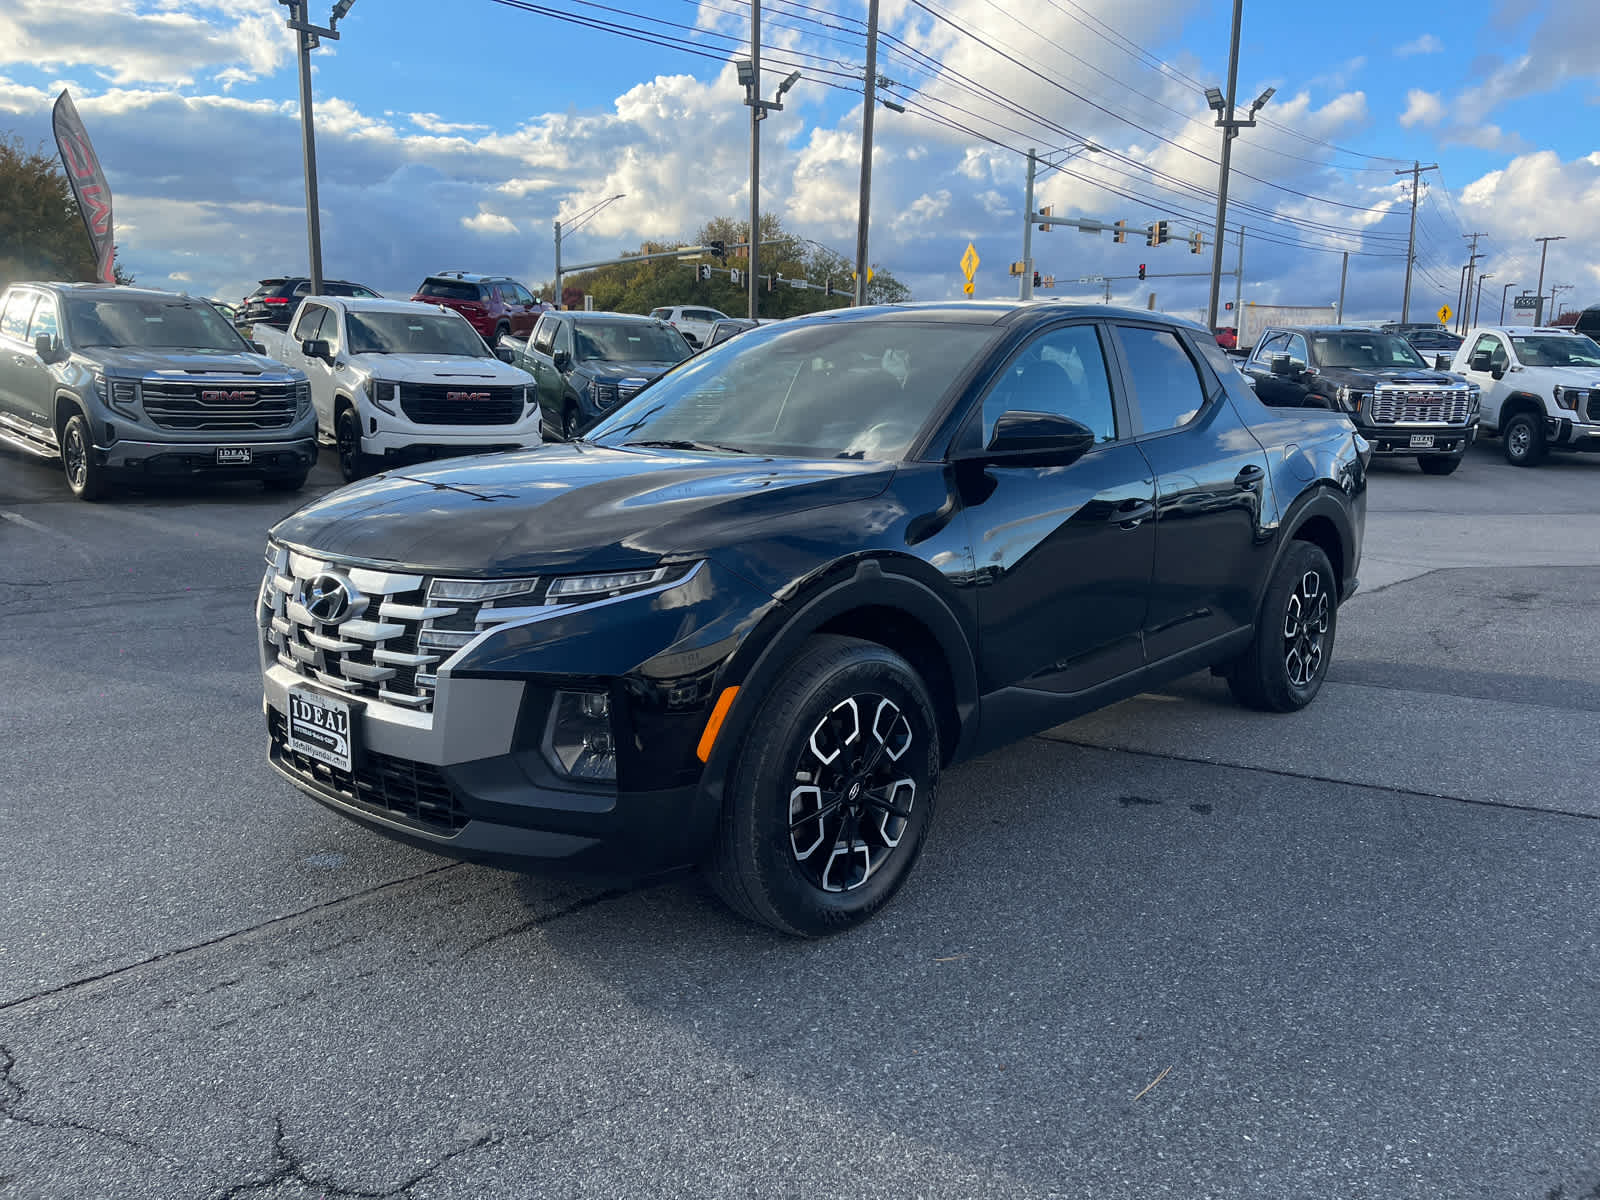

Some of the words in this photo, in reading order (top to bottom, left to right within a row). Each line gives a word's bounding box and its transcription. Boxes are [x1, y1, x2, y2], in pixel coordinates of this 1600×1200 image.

[202, 390, 256, 401] GMC
[447, 391, 491, 401] GMC
[292, 699, 347, 735] IDEAL
